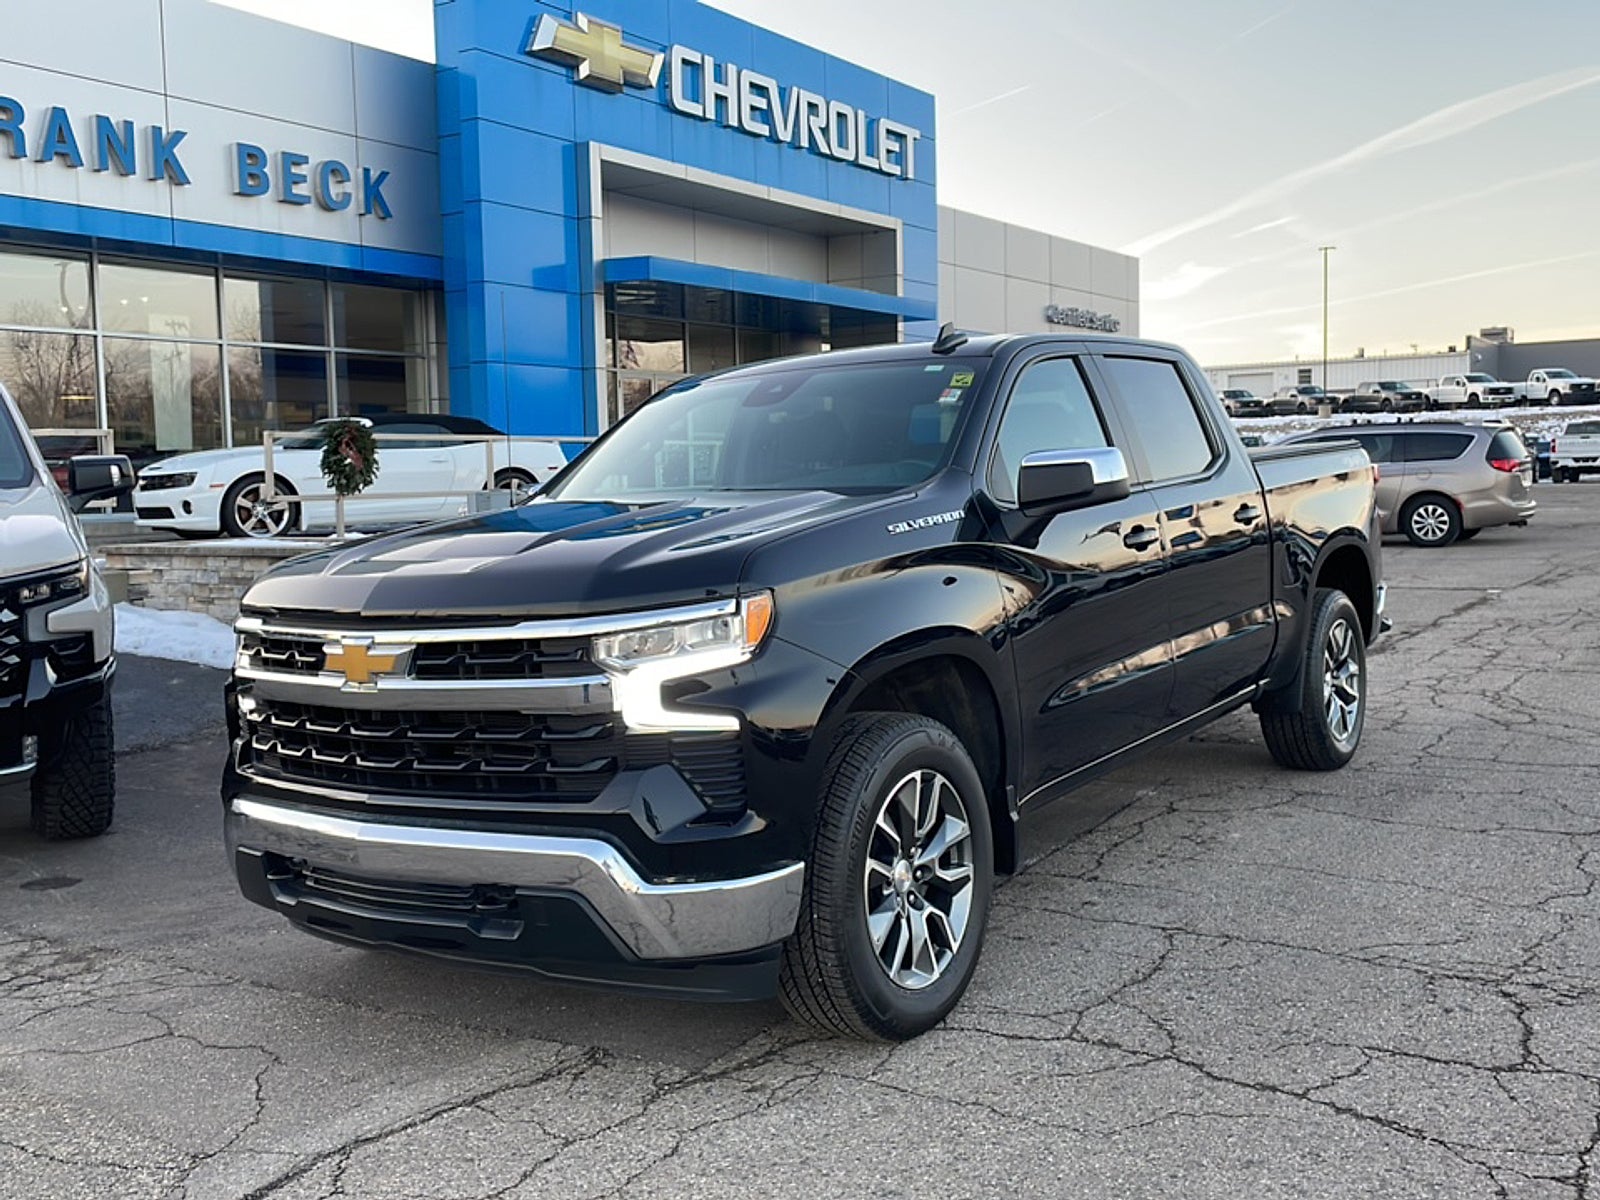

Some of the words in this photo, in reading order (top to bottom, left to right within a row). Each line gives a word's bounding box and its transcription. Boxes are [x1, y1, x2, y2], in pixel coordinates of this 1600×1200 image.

[669, 44, 921, 179] CHEVROLET
[231, 141, 393, 219] BECK
[886, 509, 966, 535] SILVERADO
